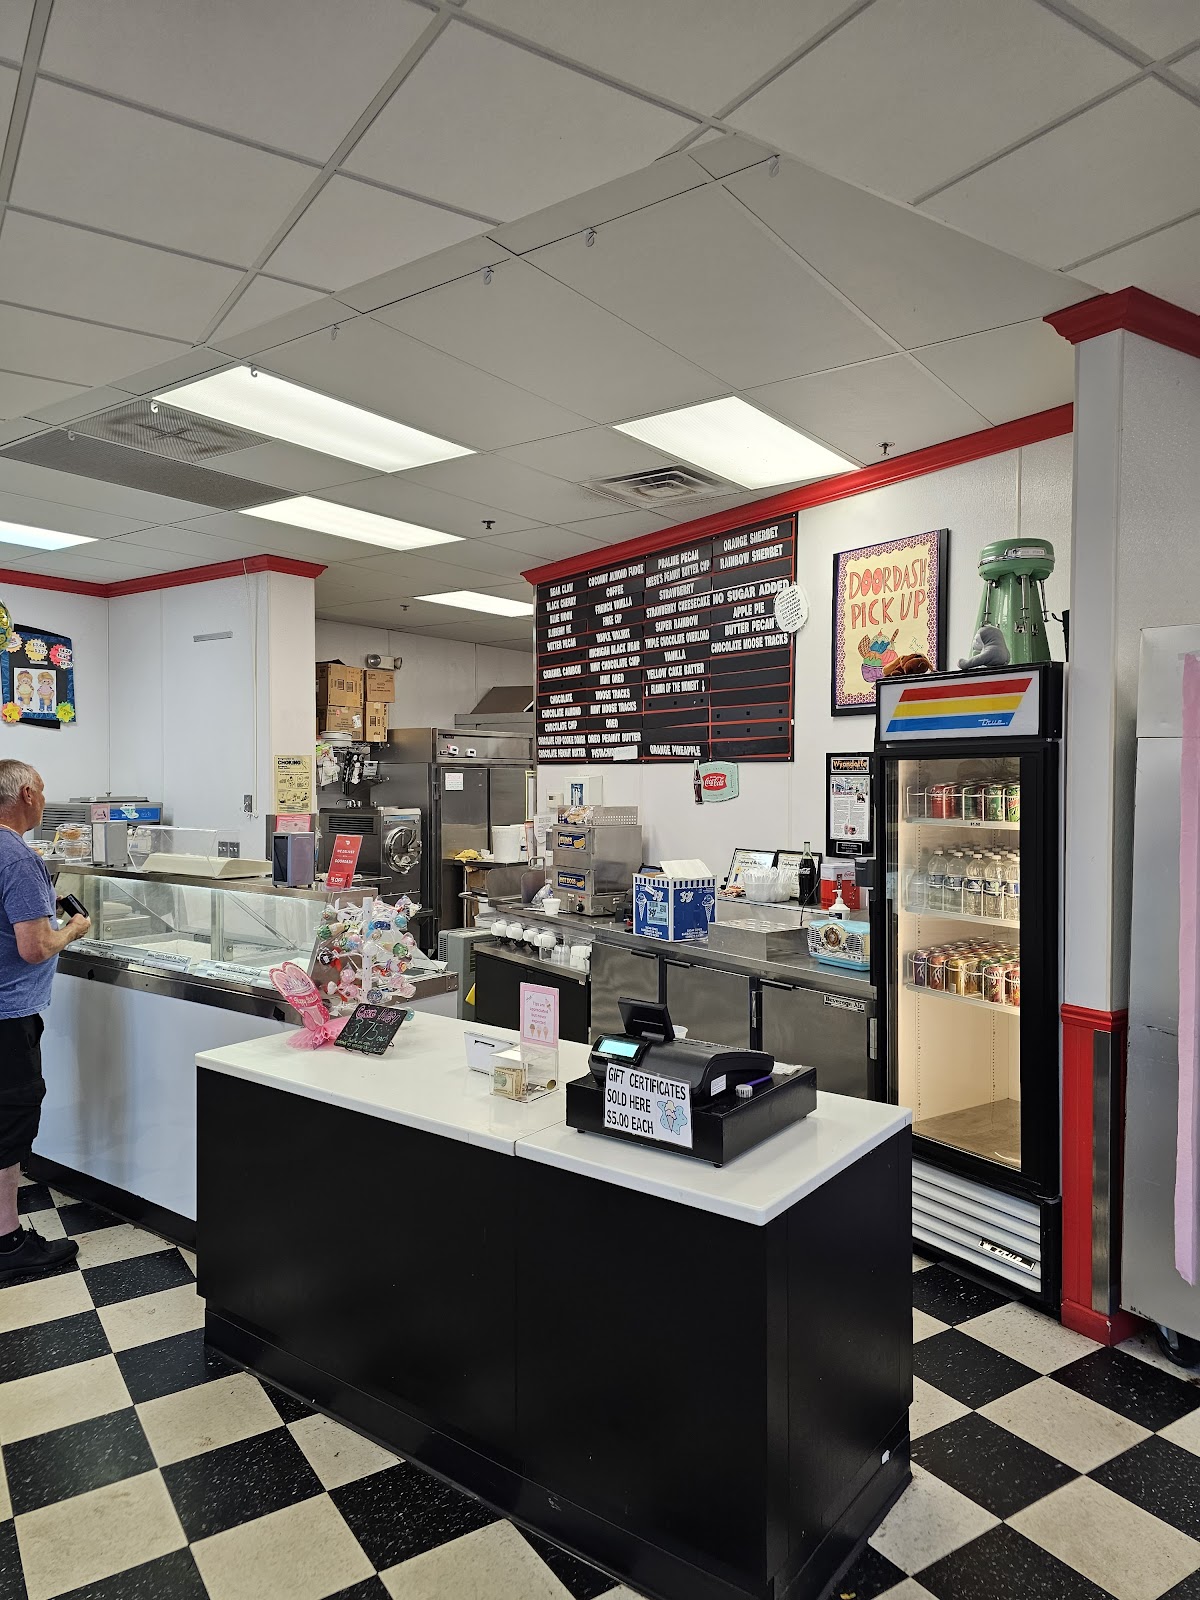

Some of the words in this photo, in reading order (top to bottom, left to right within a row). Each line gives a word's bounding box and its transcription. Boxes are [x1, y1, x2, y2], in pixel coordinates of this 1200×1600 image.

[723, 536, 748, 551] ORANGE
[750, 526, 778, 544] SHERBET
[658, 555, 679, 569] PRALINE
[681, 549, 699, 564] PECAN
[720, 552, 749, 569] RAINBOW
[752, 544, 783, 562] SHERBET
[588, 573, 608, 587] COCONUT
[609, 568, 627, 582] ALMOND
[628, 564, 644, 576] FUDGE
[646, 574, 663, 587] REESE'S
[664, 568, 680, 582] PEANUT
[682, 563, 699, 577] BUTTER
[700, 560, 709, 572] CUP
[849, 558, 928, 600] DOORDASH
[550, 586, 561, 597] BEAR
[562, 583, 573, 594] CLAW
[606, 584, 624, 597] COFFEE
[659, 583, 694, 600] STRAWBERRY
[713, 593, 724, 605] NO
[727, 586, 756, 602] SUGAR
[759, 580, 789, 596] ADDED
[546, 600, 559, 611] BLACK
[595, 602, 612, 615] FRENCH
[613, 596, 632, 610] VANILLA
[646, 602, 676, 618] STRAWBERRY
[678, 595, 710, 611] CHEESECAKE
[733, 604, 752, 618] APPLE
[754, 602, 765, 614] PIE
[851, 597, 894, 629] PICK
[900, 589, 926, 620] UP
[655, 620, 672, 632] SUPER
[674, 615, 698, 629] RAINBOW
[725, 622, 749, 636] BUTTER
[752, 617, 775, 632] PECAN
[612, 628, 630, 640] WALNUT
[645, 638, 659, 648] TRIPLE
[660, 633, 685, 646] CHOCOLATE
[686, 629, 709, 643] OVERLOAD
[547, 641, 562, 651] BUTTER
[562, 638, 576, 648] PECAN
[589, 646, 610, 658] MICHIGAN
[611, 643, 626, 654] BLACK
[627, 641, 640, 652] BEAR
[711, 640, 742, 653] CHOCOLATE
[743, 636, 763, 650] MOOSE
[765, 633, 788, 646] TRACKS
[601, 658, 628, 670] CHOCOLATE
[629, 656, 640, 666] CHIP
[664, 649, 686, 662] VANILLA
[600, 675, 610, 685] MINT
[612, 673, 624, 684] OREO
[647, 668, 667, 680] YELLOW
[668, 666, 682, 677] CAKE
[684, 663, 704, 675] BATTER
[595, 690, 611, 700] MOOSE
[612, 688, 630, 699] TRACKS
[651, 684, 665, 694] FLAVOR
[666, 683, 671, 693] OF
[672, 682, 680, 692] THE
[681, 680, 699, 692] MOMENT
[550, 693, 573, 704] CHOCOLATE
[542, 708, 564, 718] CHOCOLATE
[565, 707, 581, 716] ALMOND
[590, 705, 600, 714] MINT
[602, 703, 617, 713] MOOSE
[618, 701, 637, 712] TRACKS
[545, 722, 567, 732] CHOCOLATE
[568, 720, 577, 730] CHIP
[606, 718, 618, 728] OREO
[588, 734, 600, 743] OREO
[602, 733, 620, 743] PEANUT
[622, 732, 641, 742] BUTTER
[572, 748, 586, 757] BUTTER
[650, 745, 671, 755] ORANGE
[672, 745, 701, 756] PINEAPPLE
[630, 1073, 686, 1100] CERTIFICATES
[607, 1088, 626, 1106] SOLD
[630, 1094, 651, 1113] HERE
[607, 1110, 629, 1128] $5.00
[632, 1116, 654, 1134] EACH
